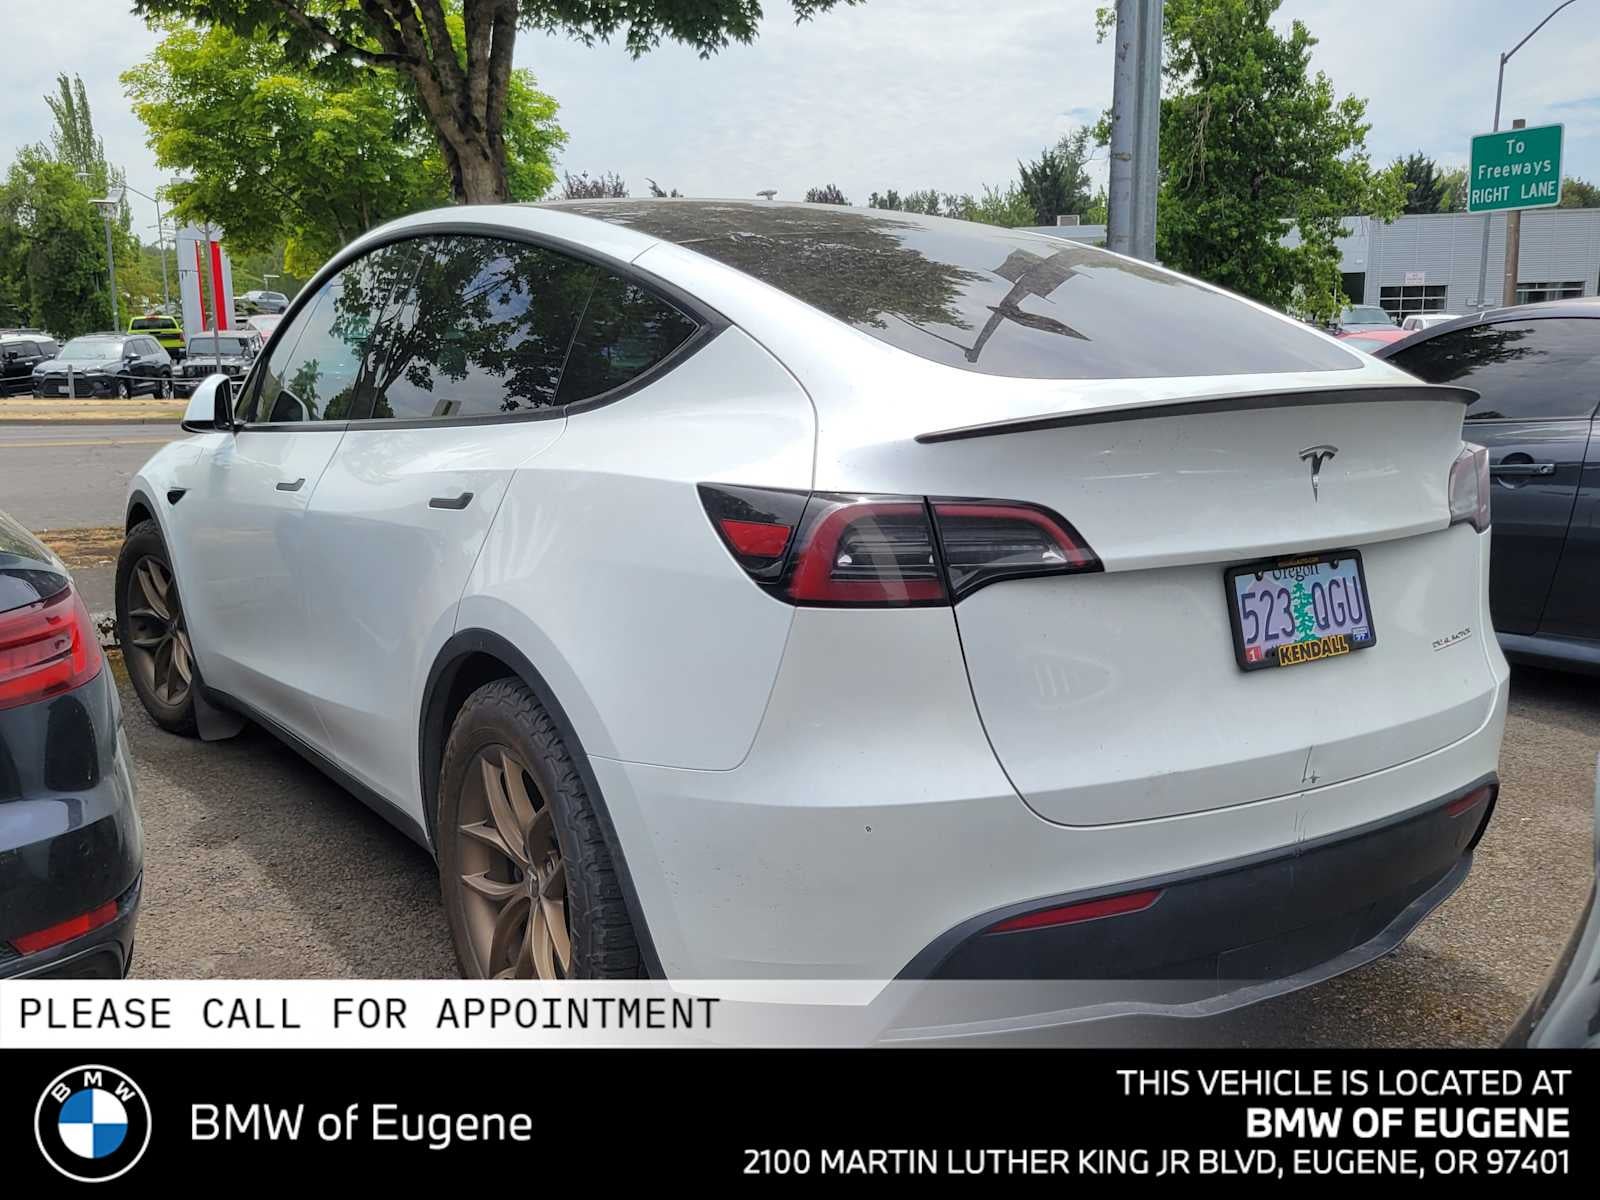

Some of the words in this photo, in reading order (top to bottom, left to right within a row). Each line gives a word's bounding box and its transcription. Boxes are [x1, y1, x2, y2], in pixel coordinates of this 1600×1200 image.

[1506, 139, 1525, 155] To
[1478, 160, 1551, 180] Freeways
[1471, 186, 1510, 205] RIGHT
[1521, 181, 1557, 199] LANE
[1241, 588, 1296, 643] 523
[1311, 576, 1363, 630] QGU
[1279, 635, 1349, 666] KENDALL
